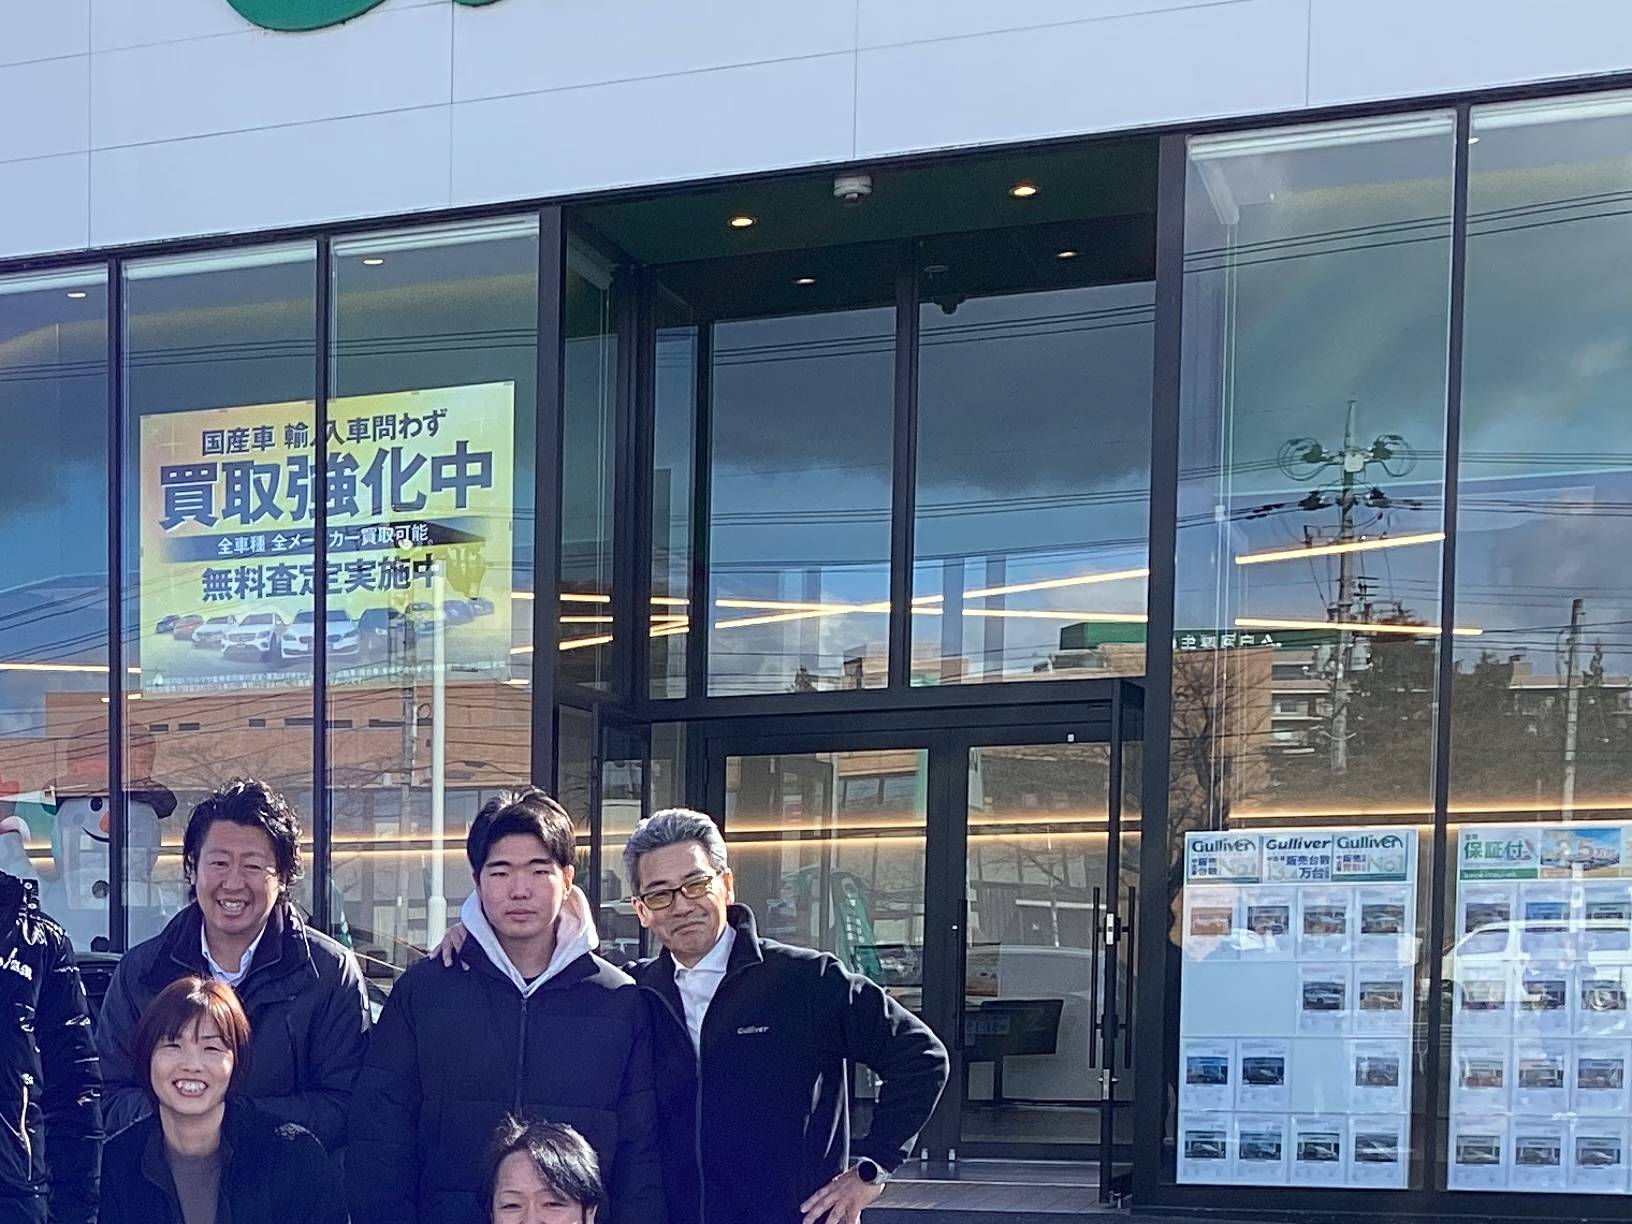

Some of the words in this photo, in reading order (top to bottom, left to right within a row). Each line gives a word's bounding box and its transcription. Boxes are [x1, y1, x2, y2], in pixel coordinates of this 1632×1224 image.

[201, 425, 276, 457] 国産車
[285, 408, 449, 449] 輸入車問わず
[158, 440, 493, 531] 買取強化中
[217, 534, 266, 556] 全車種
[202, 553, 440, 601] 無料査定実施中
[1266, 836, 1331, 851] Gulliver
[1337, 834, 1404, 849] Gulliver
